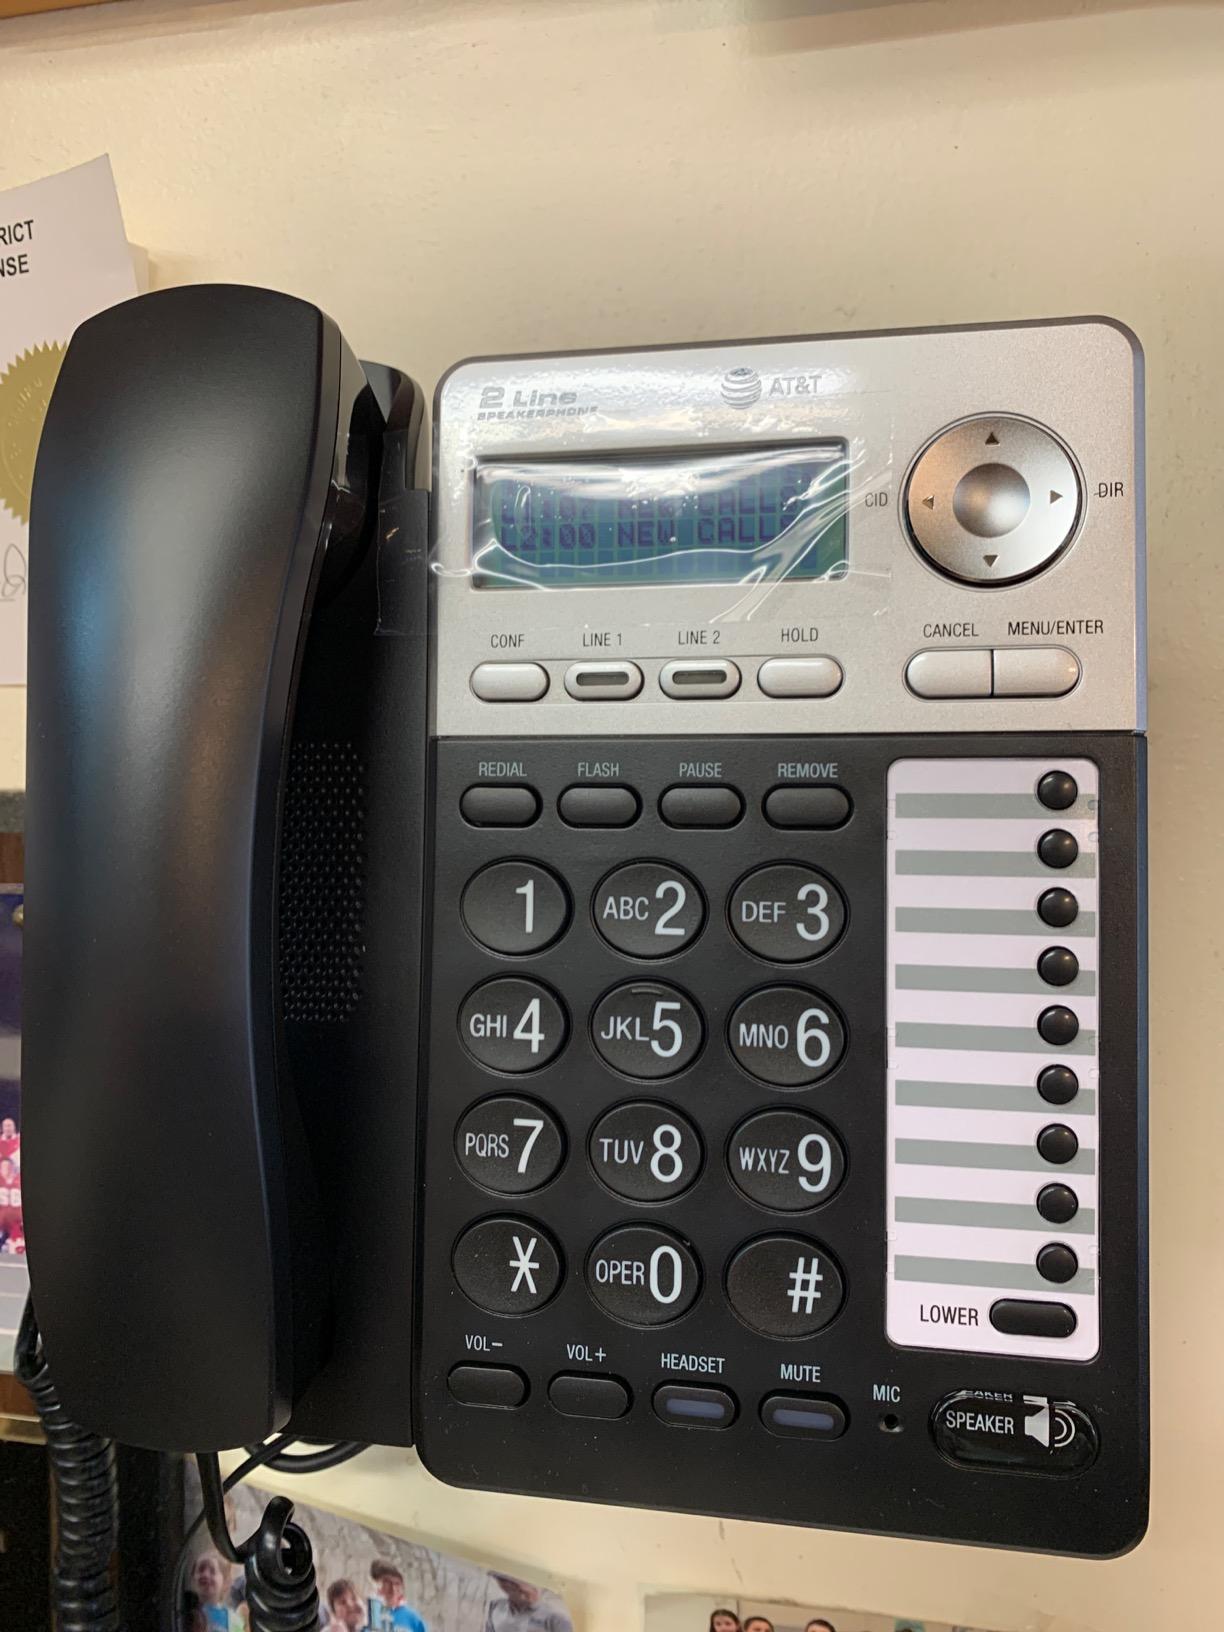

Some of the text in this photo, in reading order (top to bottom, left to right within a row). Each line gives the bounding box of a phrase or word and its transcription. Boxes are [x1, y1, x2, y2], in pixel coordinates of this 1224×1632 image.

[479, 386, 578, 408] 2 Line
[768, 376, 822, 397] AT&T
[865, 492, 888, 507] CID
[1097, 482, 1124, 498] DIR
[617, 519, 677, 549] NEW
[678, 630, 721, 645] LINE 2
[781, 627, 819, 642] HOLD
[923, 623, 979, 638] CANCEL
[1007, 619, 1104, 636] MENU/ENTER
[490, 633, 526, 648] CONF
[582, 633, 622, 647] LINE 1
[478, 762, 527, 777] REDIAL
[577, 762, 620, 777] FLASH
[679, 762, 722, 777] PAUSE
[777, 763, 838, 779] REMOVE
[515, 879, 534, 934] 1
[602, 880, 687, 936] ABC 2
[741, 883, 830, 941] DEF 3
[469, 998, 545, 1054] GHI 4
[600, 1001, 683, 1058] JKL 5
[739, 1008, 831, 1068] MNO 6
[465, 1118, 544, 1174] PQRS 7
[599, 1124, 683, 1183] TUV 8
[739, 1133, 832, 1193] WXYZ 9
[595, 1245, 683, 1304] OPER 0
[787, 1257, 823, 1314] #
[920, 1304, 979, 1326] LOWER
[660, 1353, 725, 1374] HEADSET
[780, 1364, 821, 1383] MUTE
[872, 1384, 901, 1403] MIC
[945, 1410, 1015, 1435] SPEAKER
